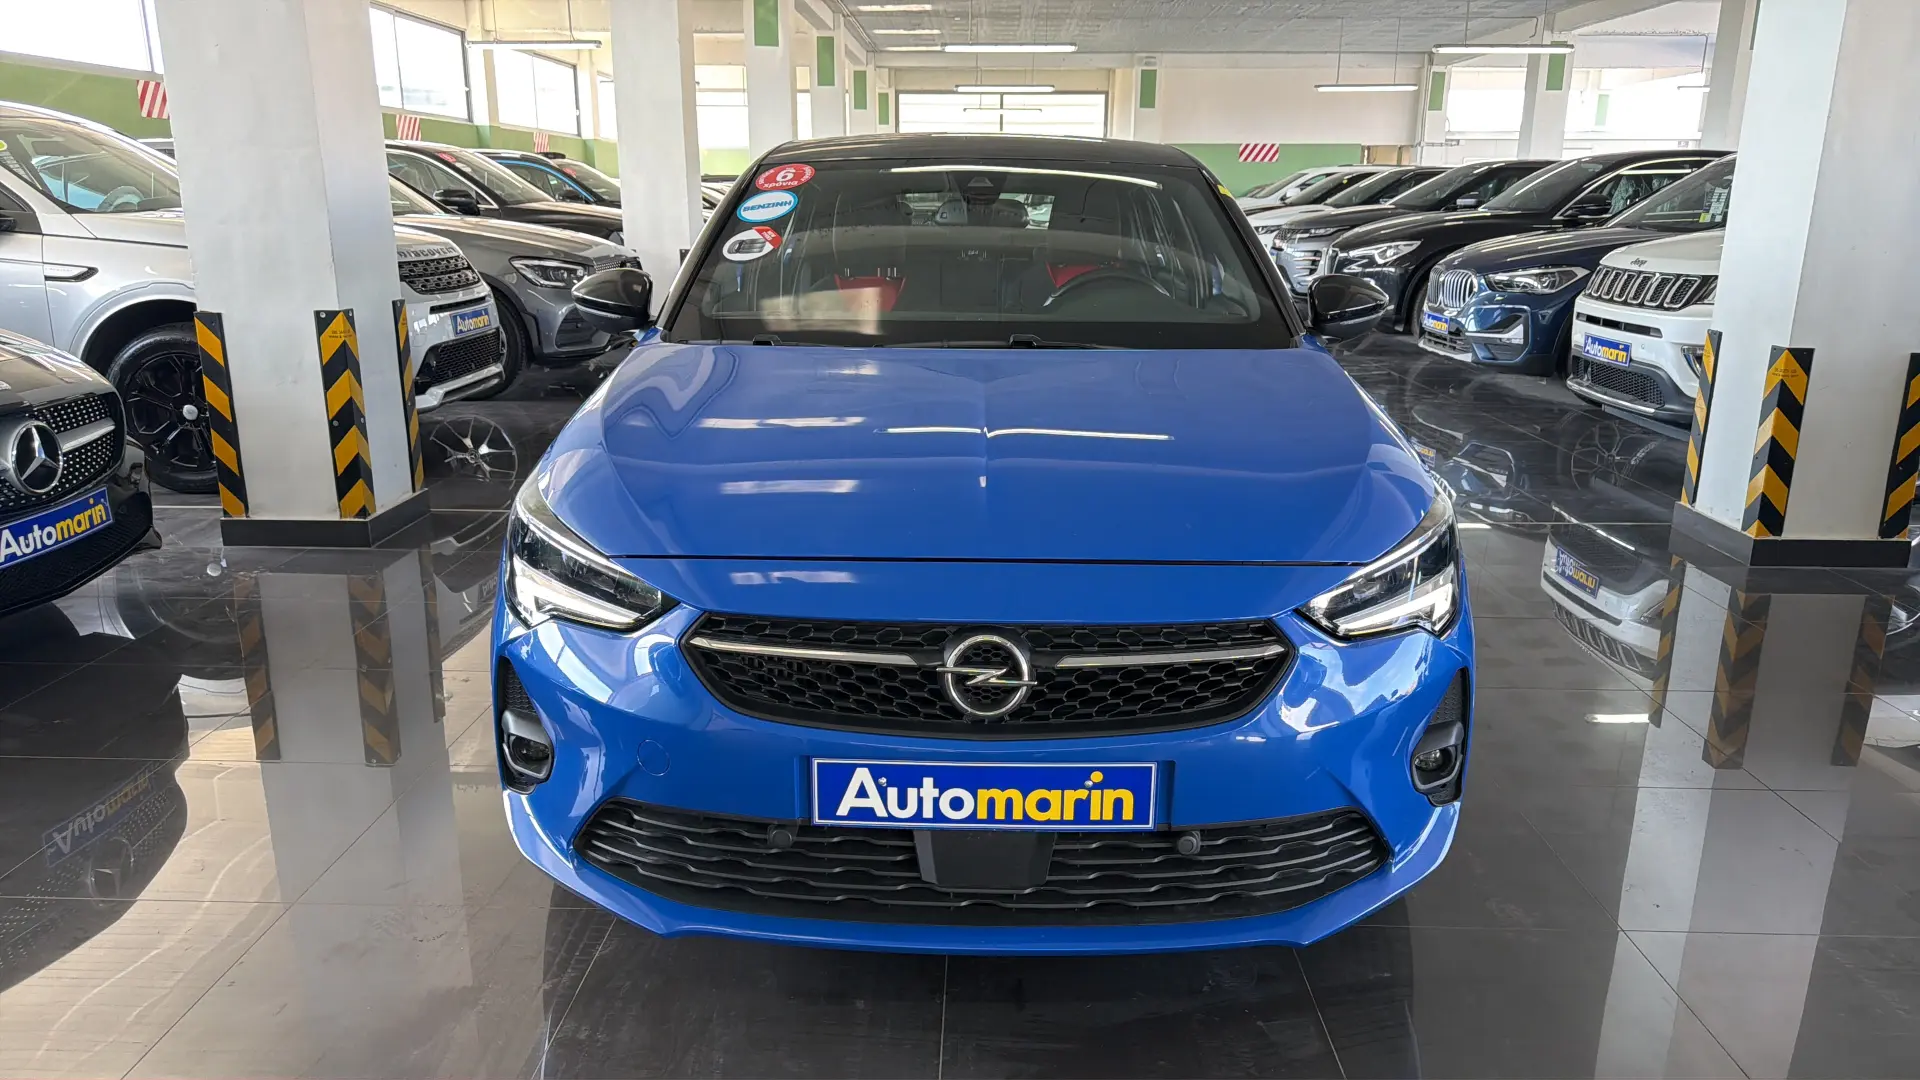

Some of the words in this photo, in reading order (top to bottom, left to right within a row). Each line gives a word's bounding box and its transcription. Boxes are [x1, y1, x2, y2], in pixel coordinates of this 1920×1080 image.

[763, 181, 799, 189] χρόνια
[776, 169, 796, 181] 6
[457, 310, 490, 333] Automarin
[1585, 337, 1627, 362] Automarin
[0, 498, 107, 563] Automarin
[836, 767, 1134, 821] Automarin
